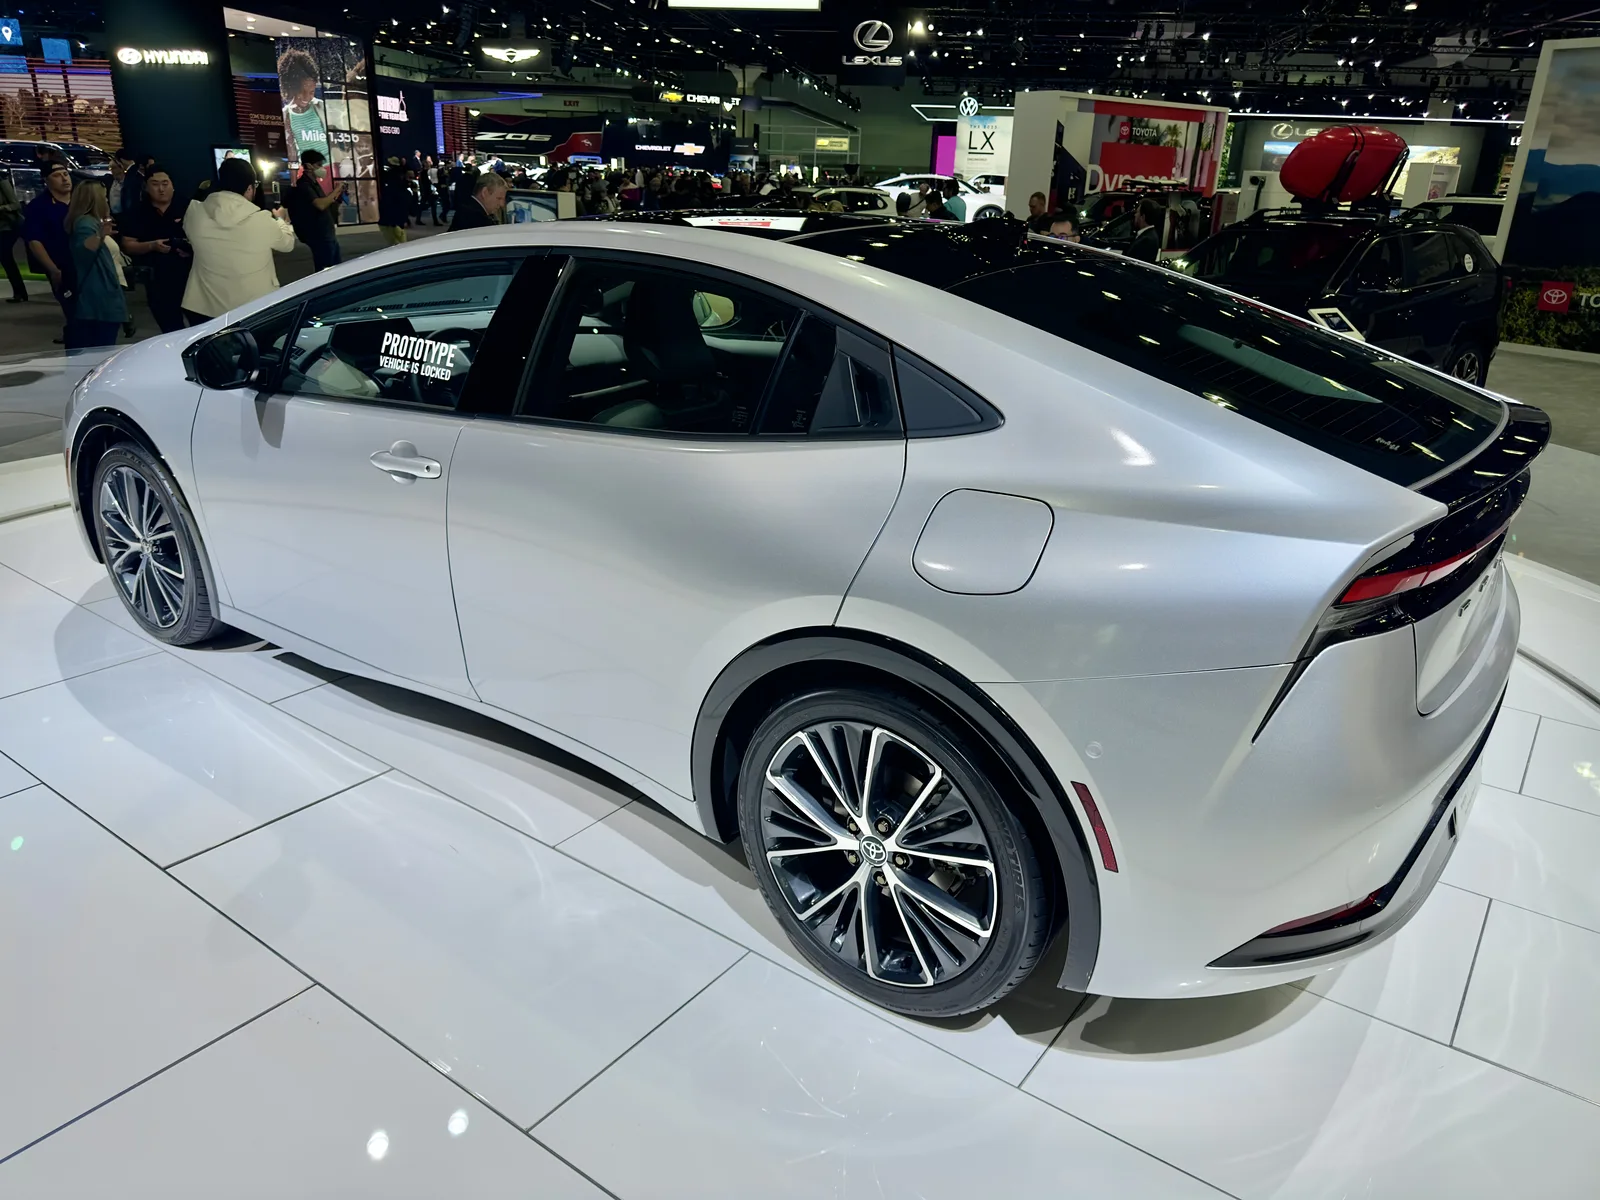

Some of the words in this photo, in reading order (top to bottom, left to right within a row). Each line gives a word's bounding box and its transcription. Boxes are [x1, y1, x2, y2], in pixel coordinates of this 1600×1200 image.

[143, 49, 209, 65] HYUNDAI
[841, 55, 903, 67] LEXUS
[686, 93, 742, 106] CHEVRET
[301, 130, 327, 141] Mile
[1132, 127, 1157, 137] TOYOTA
[968, 130, 995, 150] LX
[381, 332, 457, 368] PROTOTYPE
[380, 355, 410, 372] VEHICLE
[411, 361, 420, 375] IS
[420, 364, 451, 381] LOCKED
